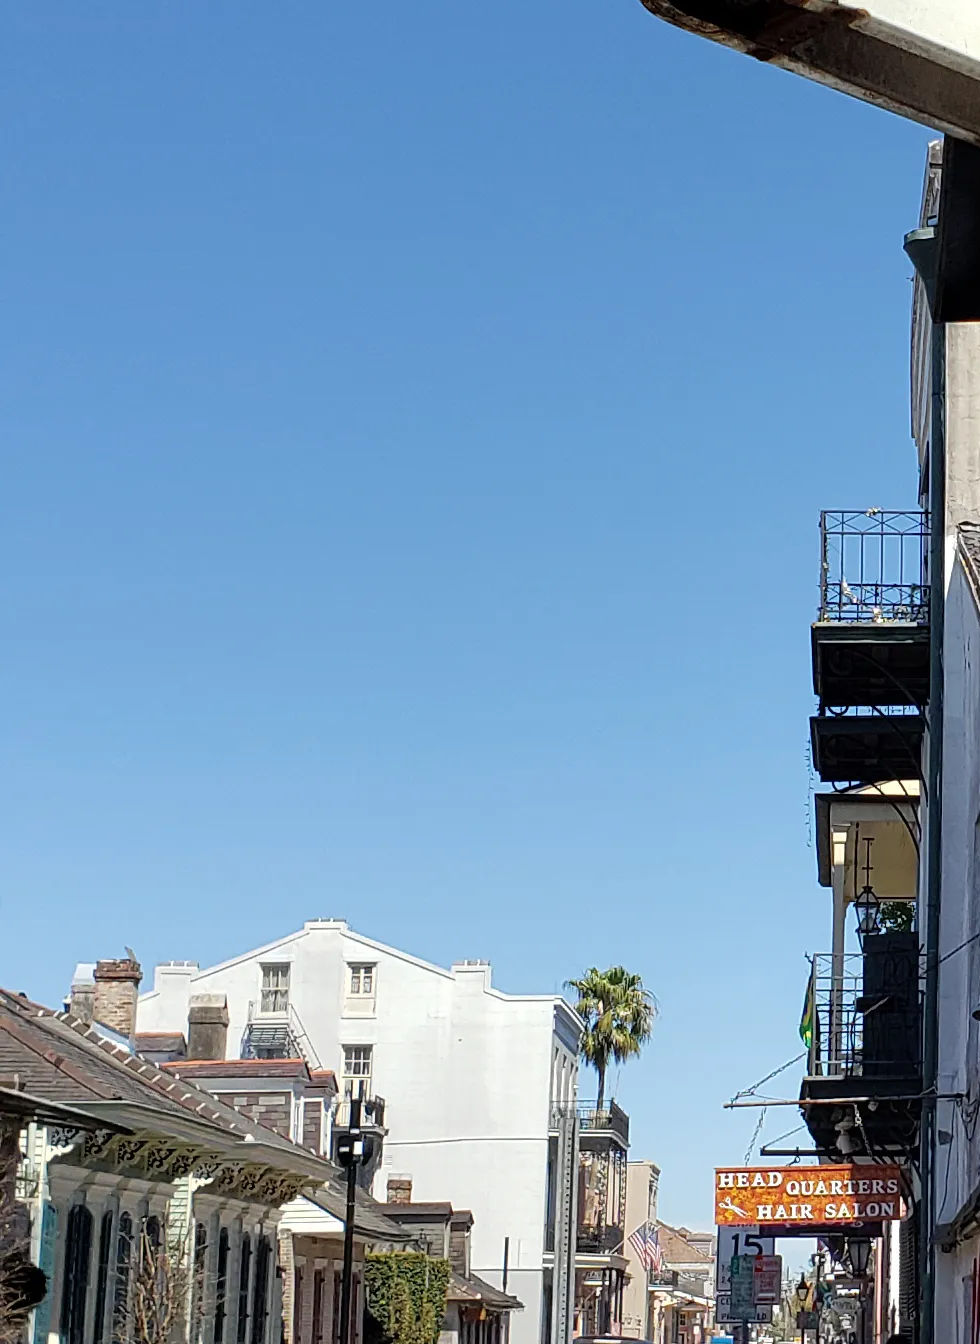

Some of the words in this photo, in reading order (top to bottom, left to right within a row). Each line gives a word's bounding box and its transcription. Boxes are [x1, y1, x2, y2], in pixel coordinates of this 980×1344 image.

[718, 1171, 783, 1189] HEAD
[786, 1179, 898, 1197] QUARTERS
[756, 1203, 815, 1221] HAIR
[824, 1201, 895, 1220] SALON
[732, 1233, 763, 1256] 15
